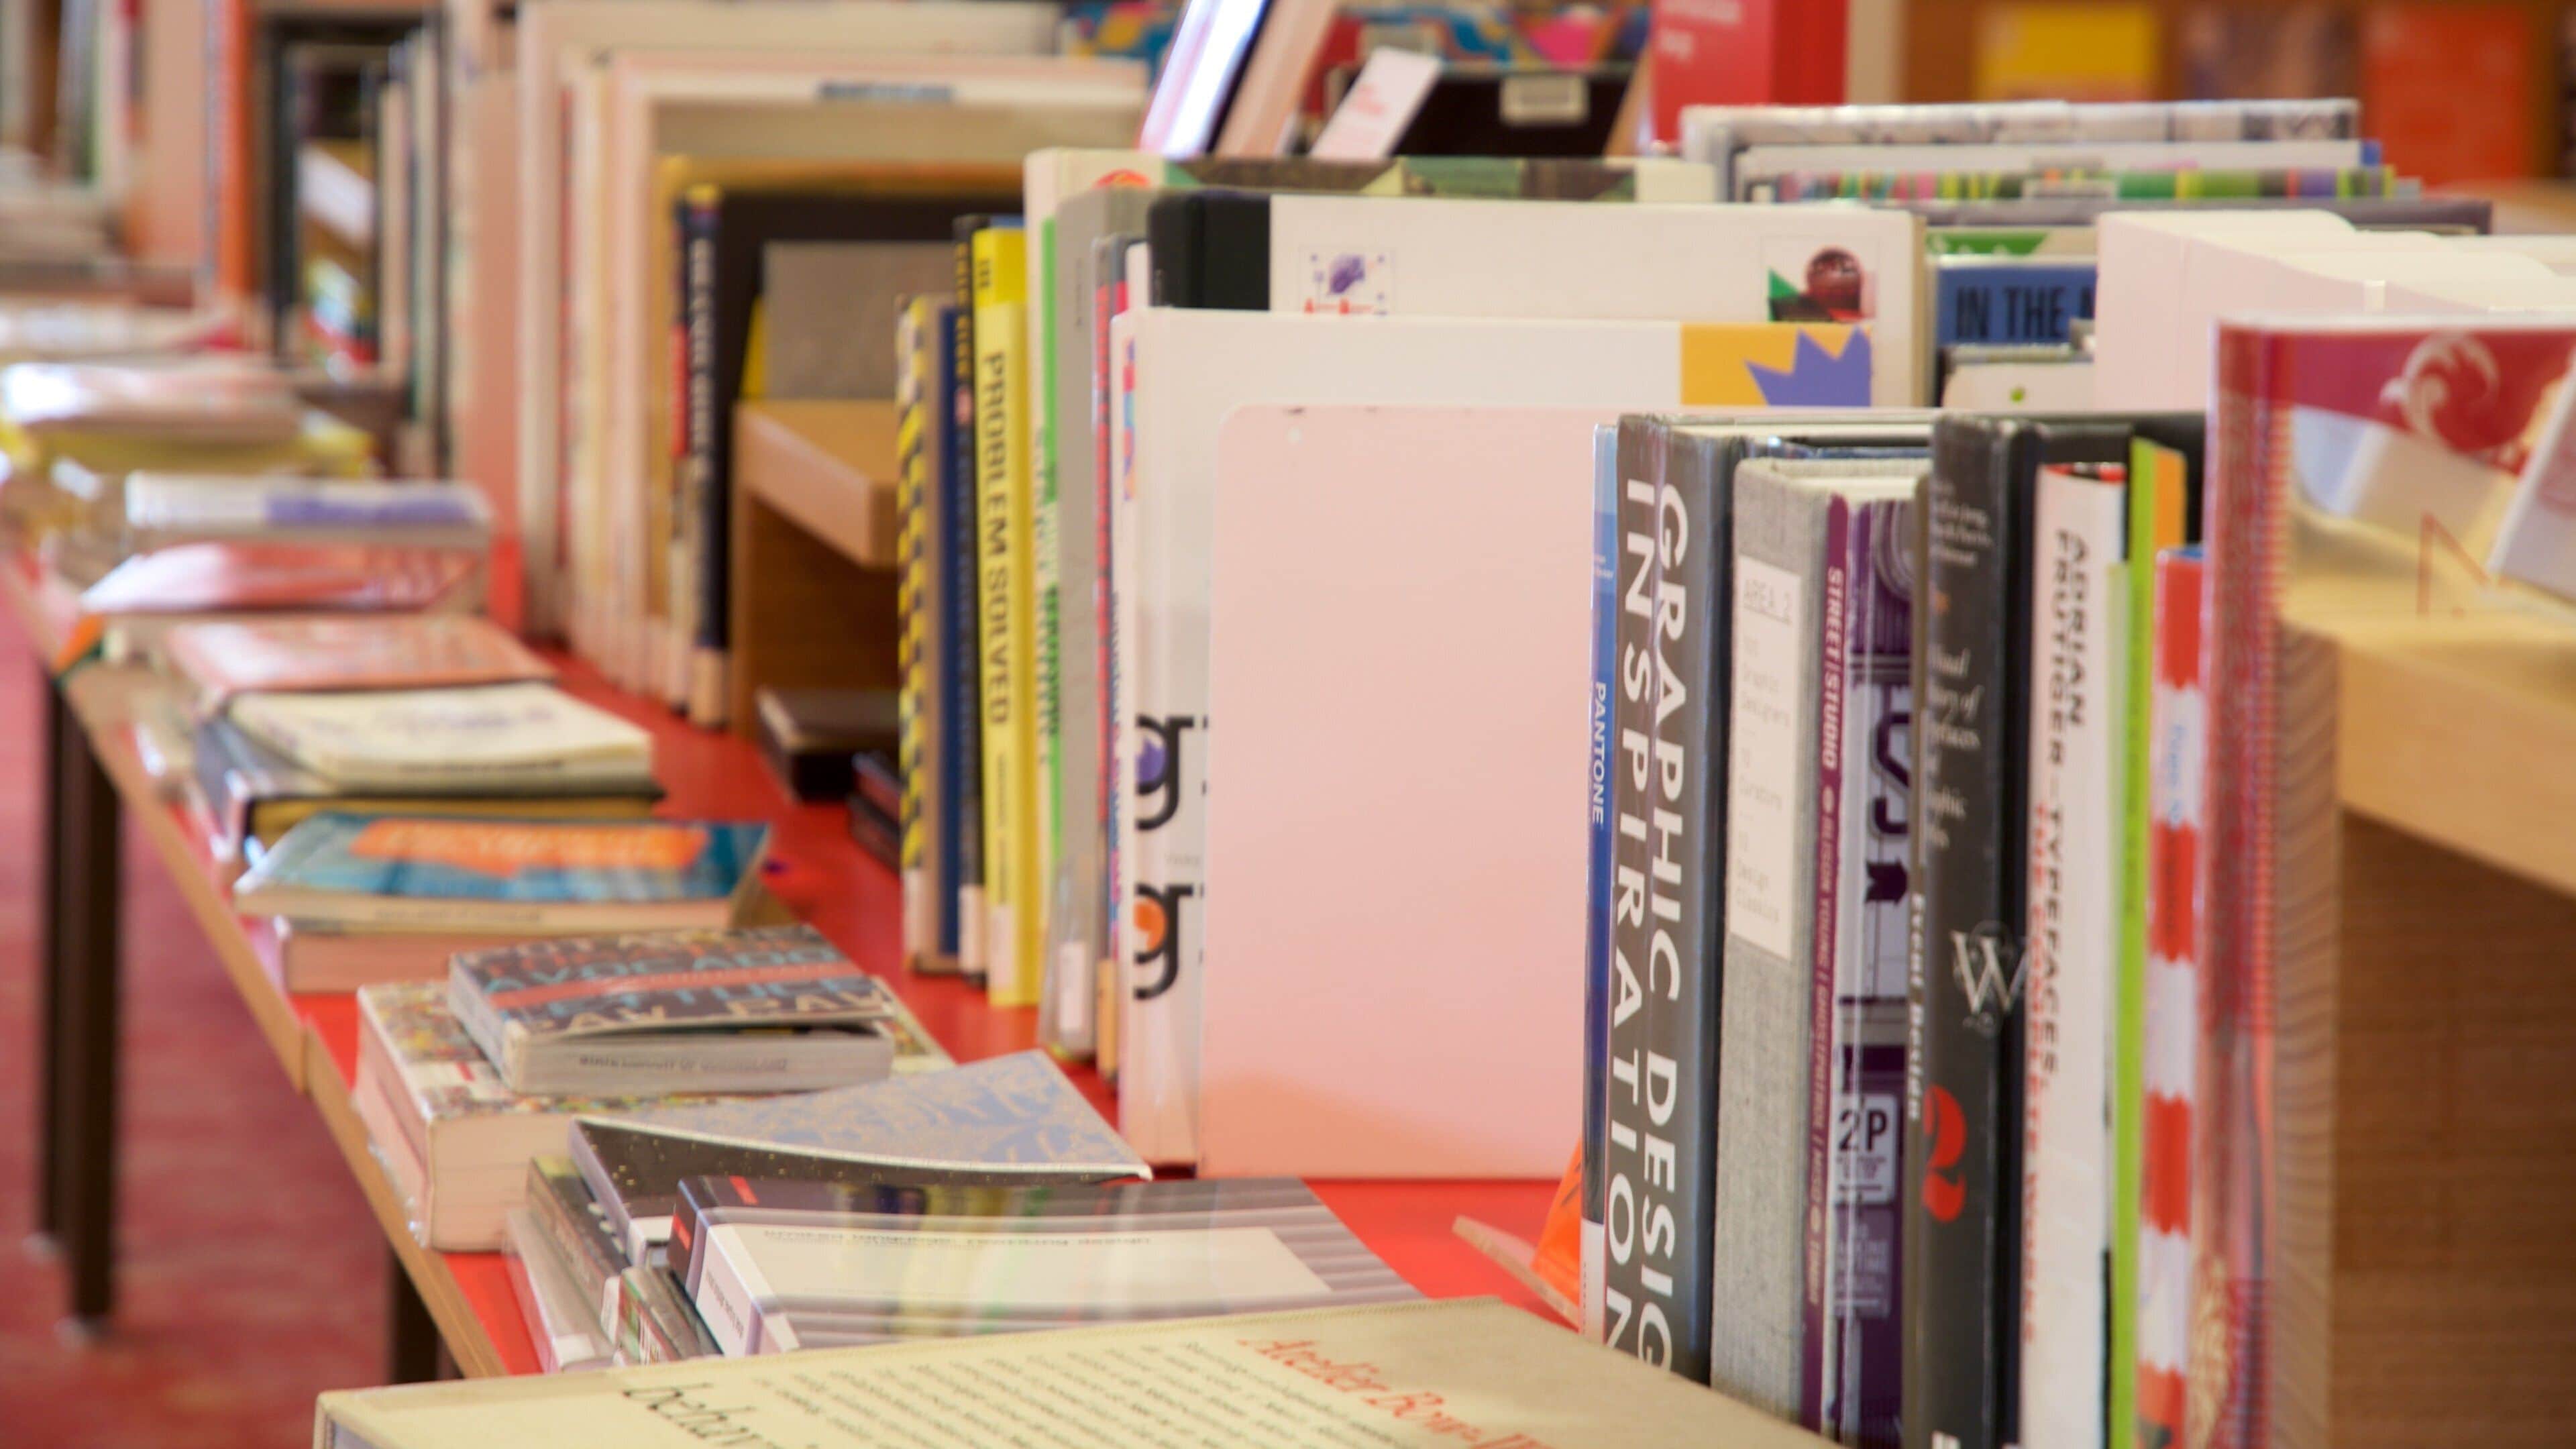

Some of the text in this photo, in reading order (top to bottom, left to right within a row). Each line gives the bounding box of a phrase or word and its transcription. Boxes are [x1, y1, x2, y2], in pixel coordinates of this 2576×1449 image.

[1955, 286, 1990, 339] IN
[2004, 286, 2065, 339] THE
[984, 353, 1010, 556] PROBLEM
[987, 568, 1011, 725] SOLVED
[1744, 578, 1775, 608] AREA
[2047, 530, 2072, 765] FRUTIGER
[2068, 534, 2090, 727] ADRIAN
[1822, 568, 1844, 771] STREET/STUDIO
[1592, 682, 1607, 828] PANTONE
[484, 949, 838, 994] AVOCADO
[1606, 479, 1655, 1350] INSPIRATION
[1638, 484, 1688, 1371] GRAPHIC DESIG
[1838, 1109, 1889, 1152] 2P
[1922, 1084, 1966, 1222] 2
[1236, 1340, 1389, 1392] Atelier
